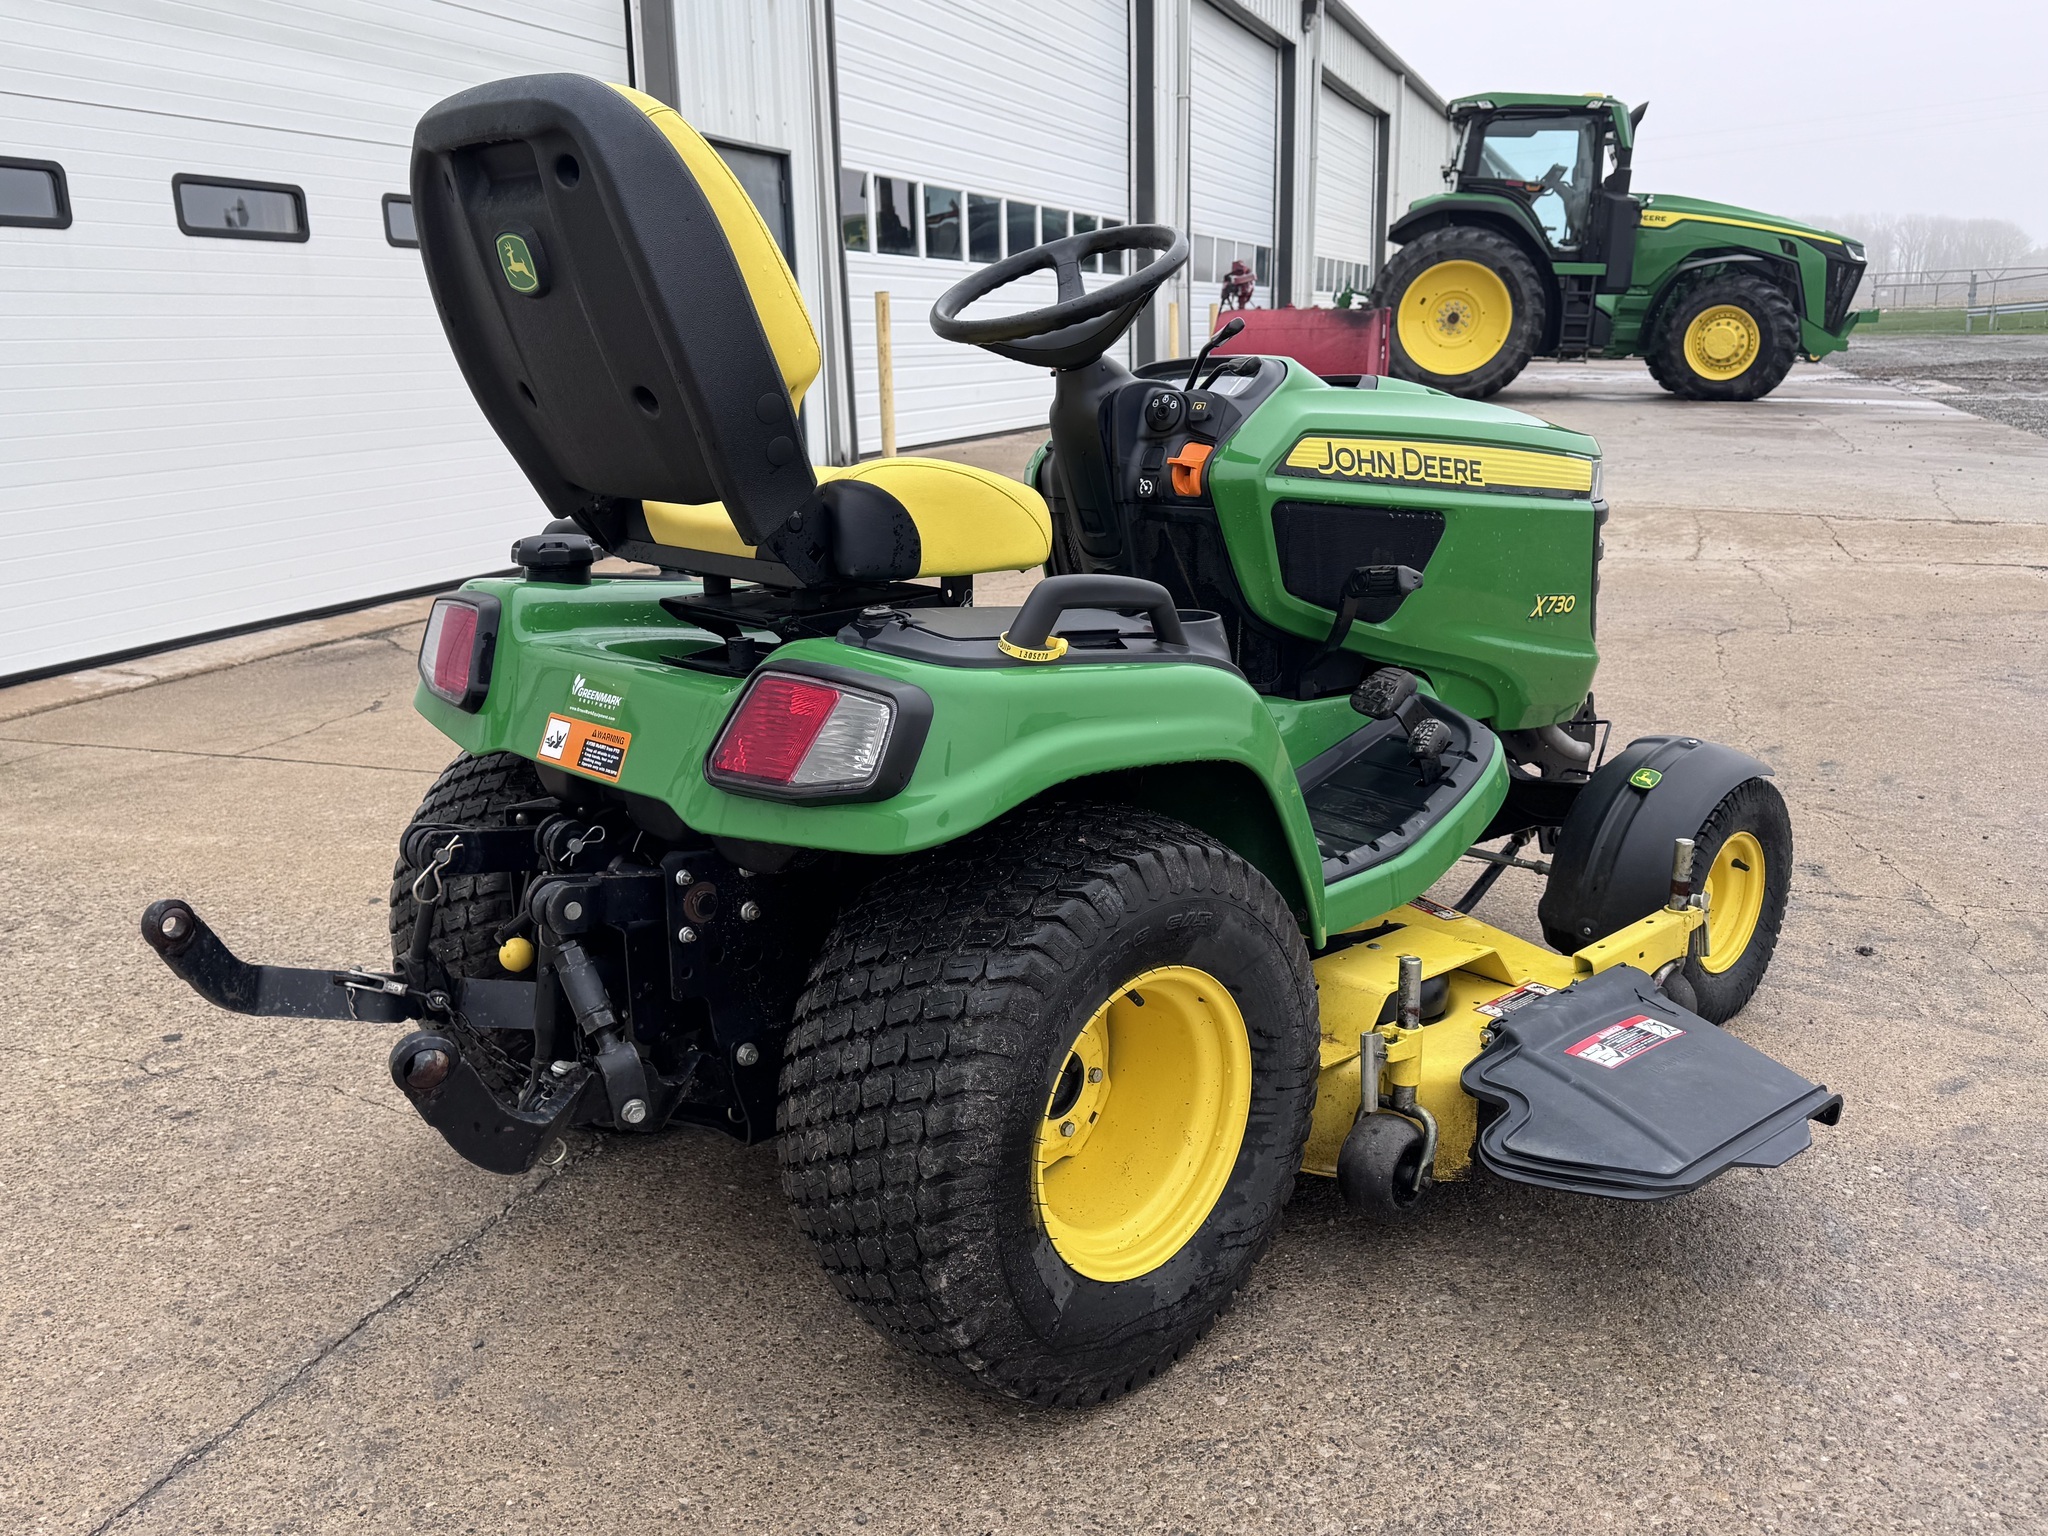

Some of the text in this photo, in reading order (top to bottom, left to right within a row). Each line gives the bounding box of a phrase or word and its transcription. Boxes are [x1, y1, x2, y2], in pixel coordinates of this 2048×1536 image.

[1641, 214, 1667, 222] EERE
[1318, 441, 1483, 483] JOHN DEERE
[1529, 594, 1576, 617] X730
[577, 687, 622, 707] GREENMARK
[598, 730, 625, 745] WARNING
